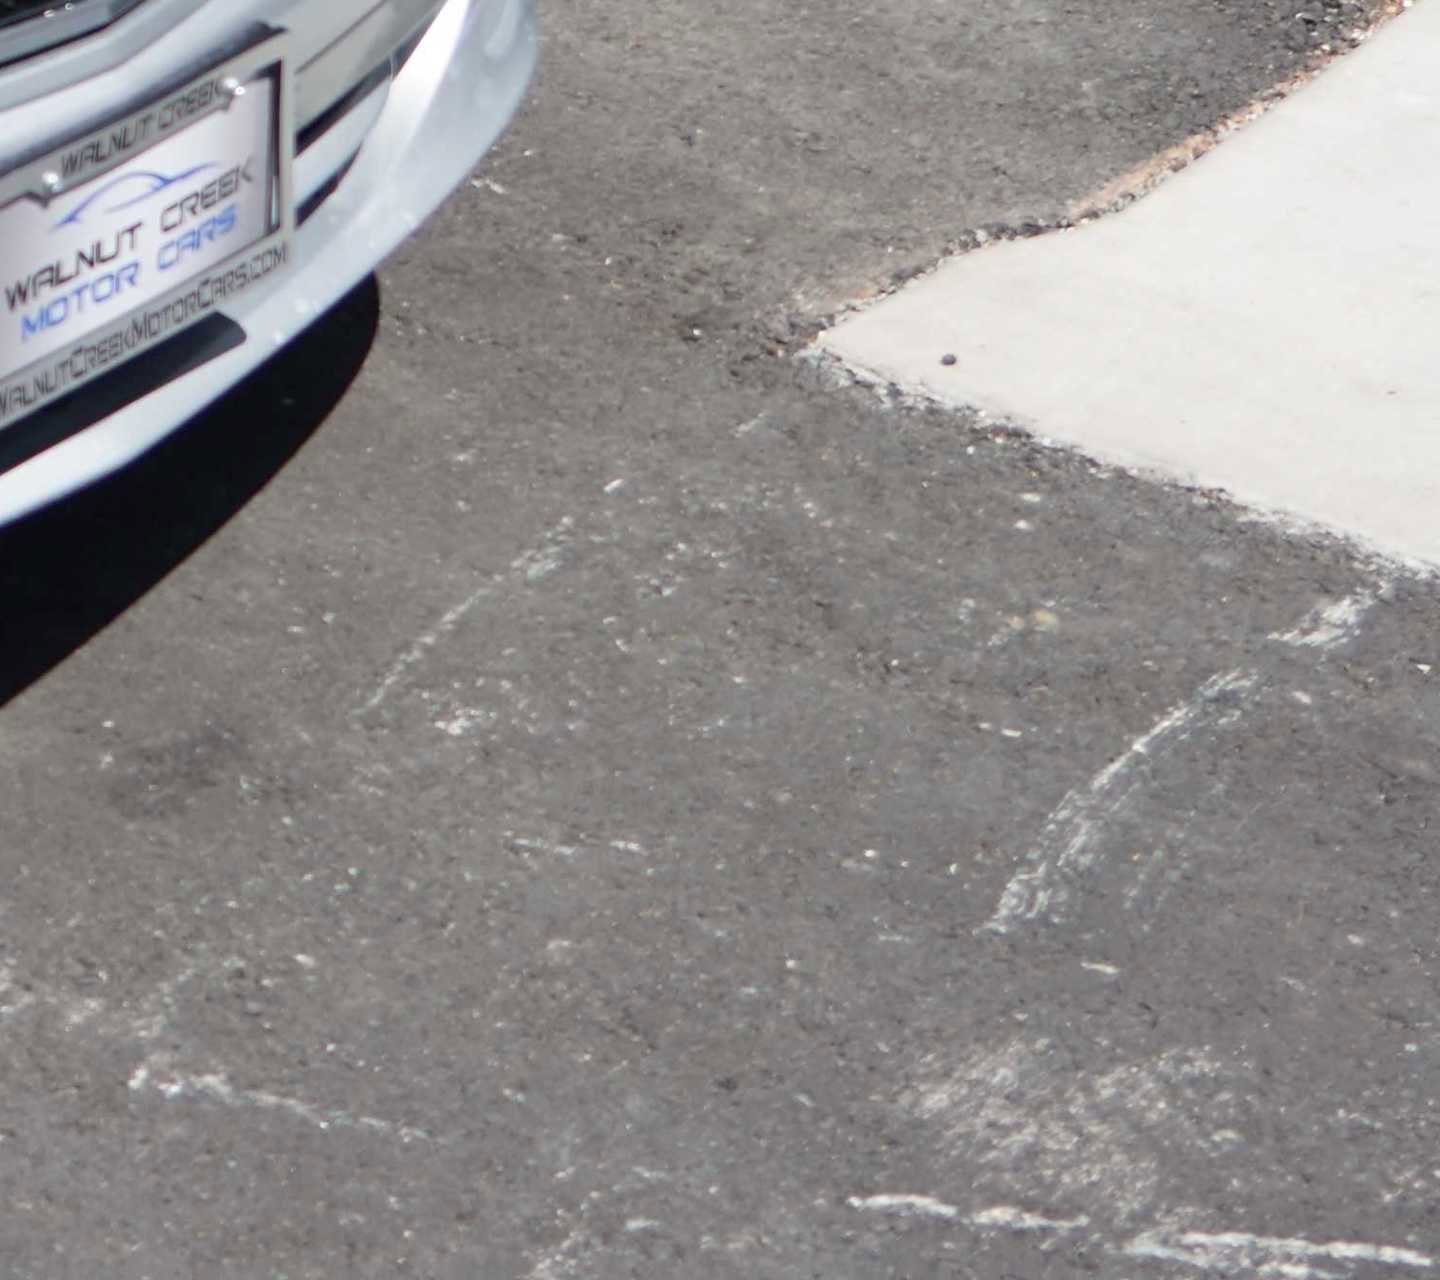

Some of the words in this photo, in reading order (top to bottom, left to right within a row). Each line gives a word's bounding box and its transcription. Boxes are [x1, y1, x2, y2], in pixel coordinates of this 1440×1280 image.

[62, 113, 153, 177] WALNUT
[4, 222, 144, 312] WALNUT
[160, 160, 256, 233] CREEK
[20, 262, 140, 341] MOTOR
[157, 205, 241, 272] CARS
